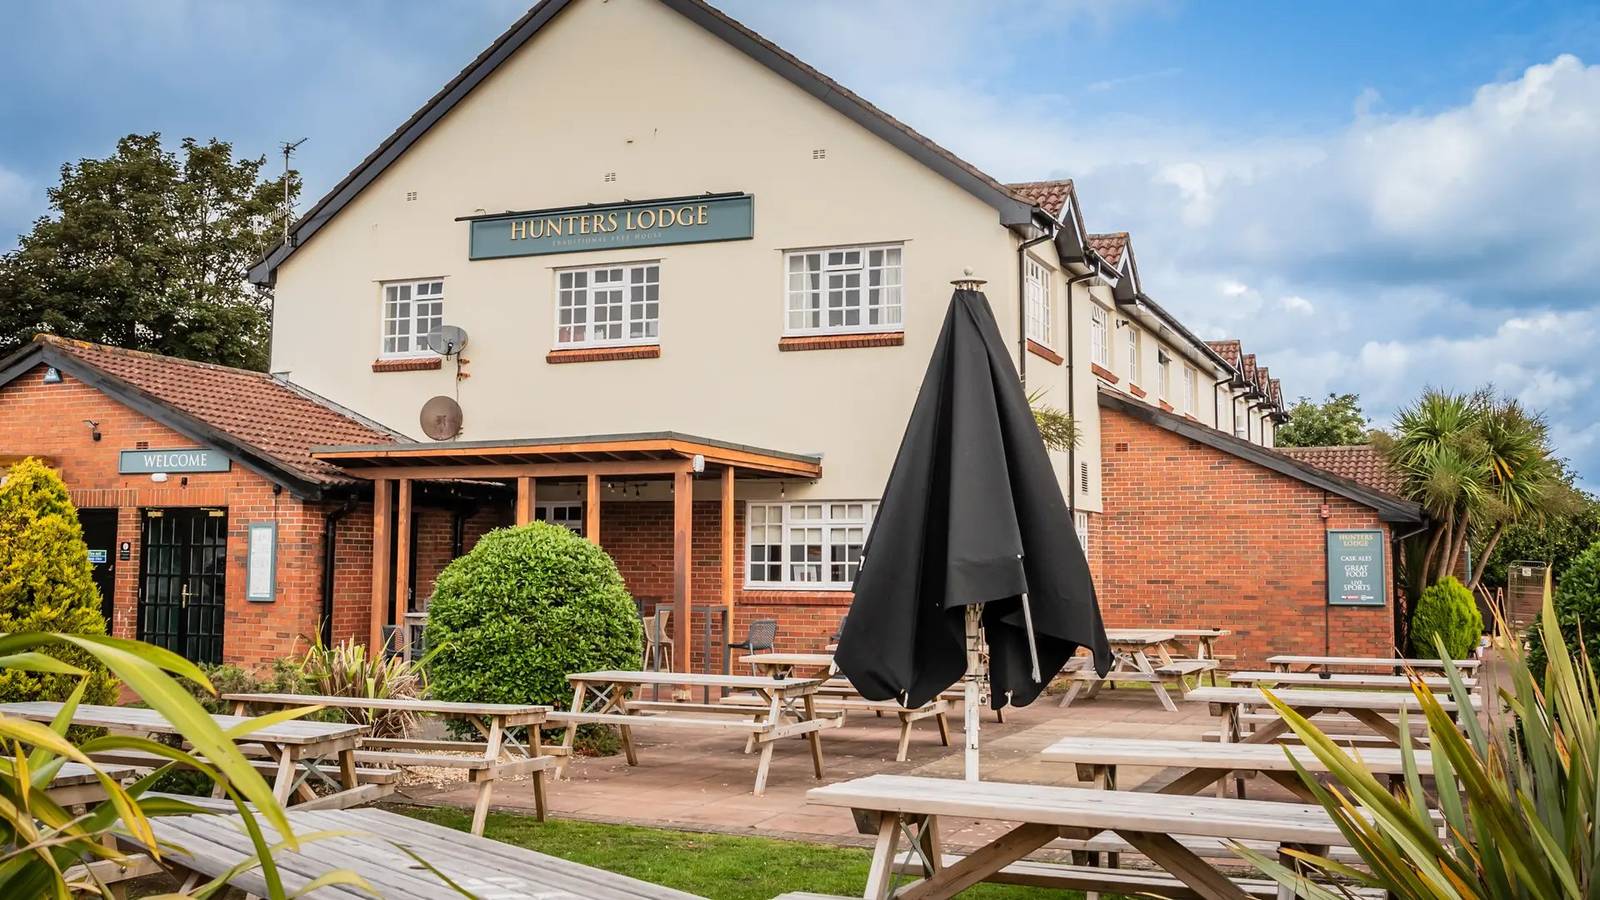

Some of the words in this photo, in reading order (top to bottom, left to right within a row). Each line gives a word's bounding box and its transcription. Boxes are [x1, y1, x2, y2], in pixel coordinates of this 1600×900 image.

[511, 212, 618, 240] HUNTERS
[626, 205, 709, 230] LODGE
[144, 453, 207, 467] WELCOME
